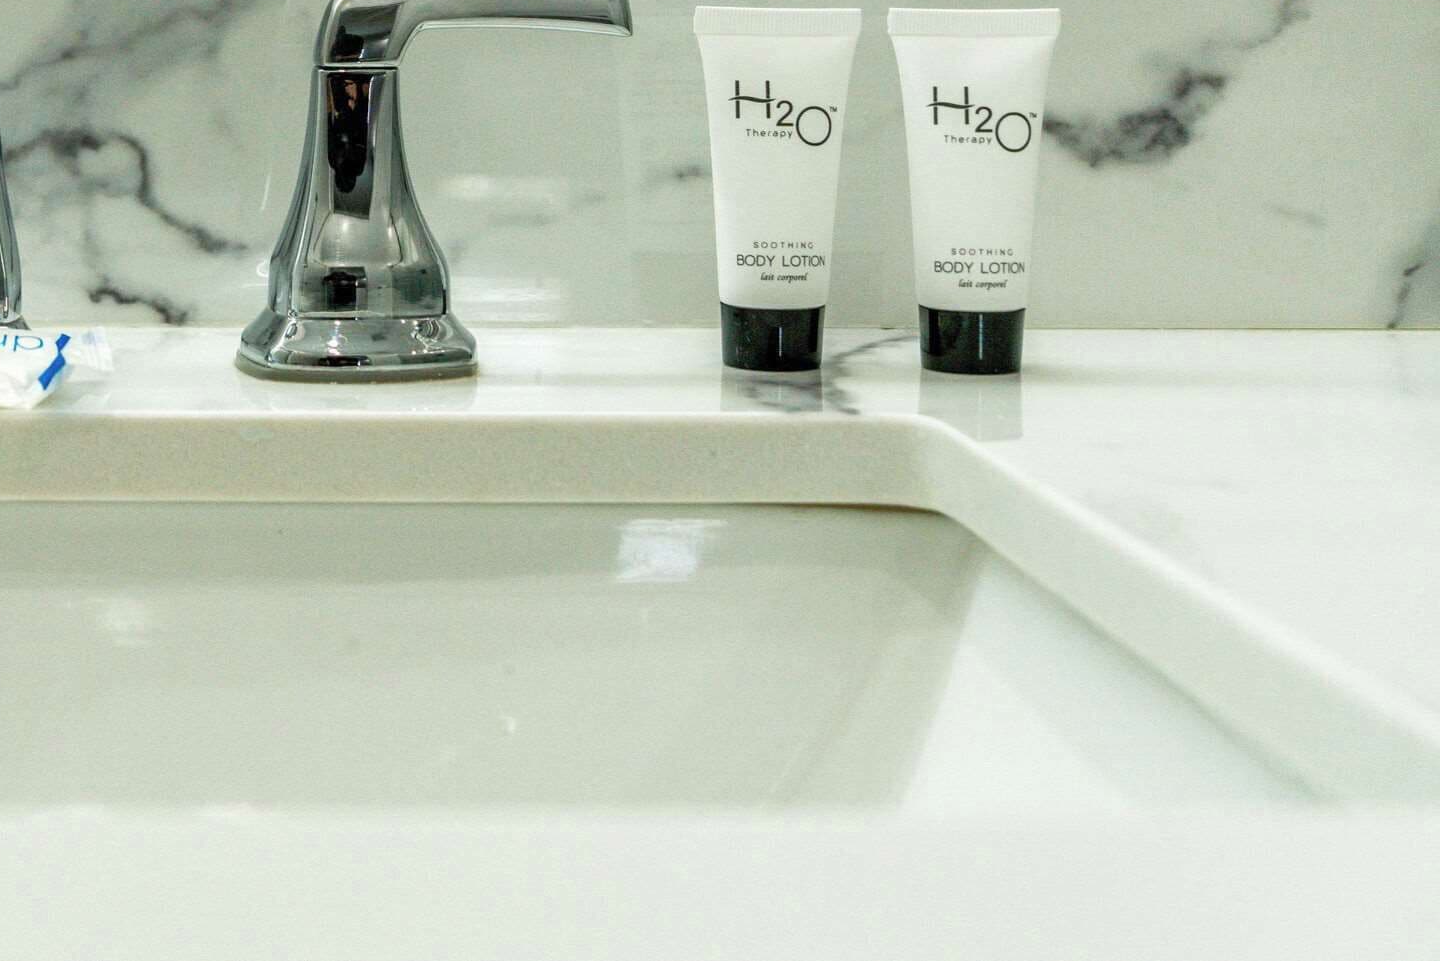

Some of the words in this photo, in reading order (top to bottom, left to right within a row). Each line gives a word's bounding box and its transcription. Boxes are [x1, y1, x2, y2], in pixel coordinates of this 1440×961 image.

[745, 128, 793, 139] Therapy
[944, 135, 992, 144] Therapy
[753, 241, 814, 249] SOOTHING
[951, 248, 1014, 256] SOOTHING
[736, 254, 775, 267] BODY
[782, 255, 825, 267] LOTION
[934, 261, 974, 273] BODY
[980, 262, 1025, 274] LOTION
